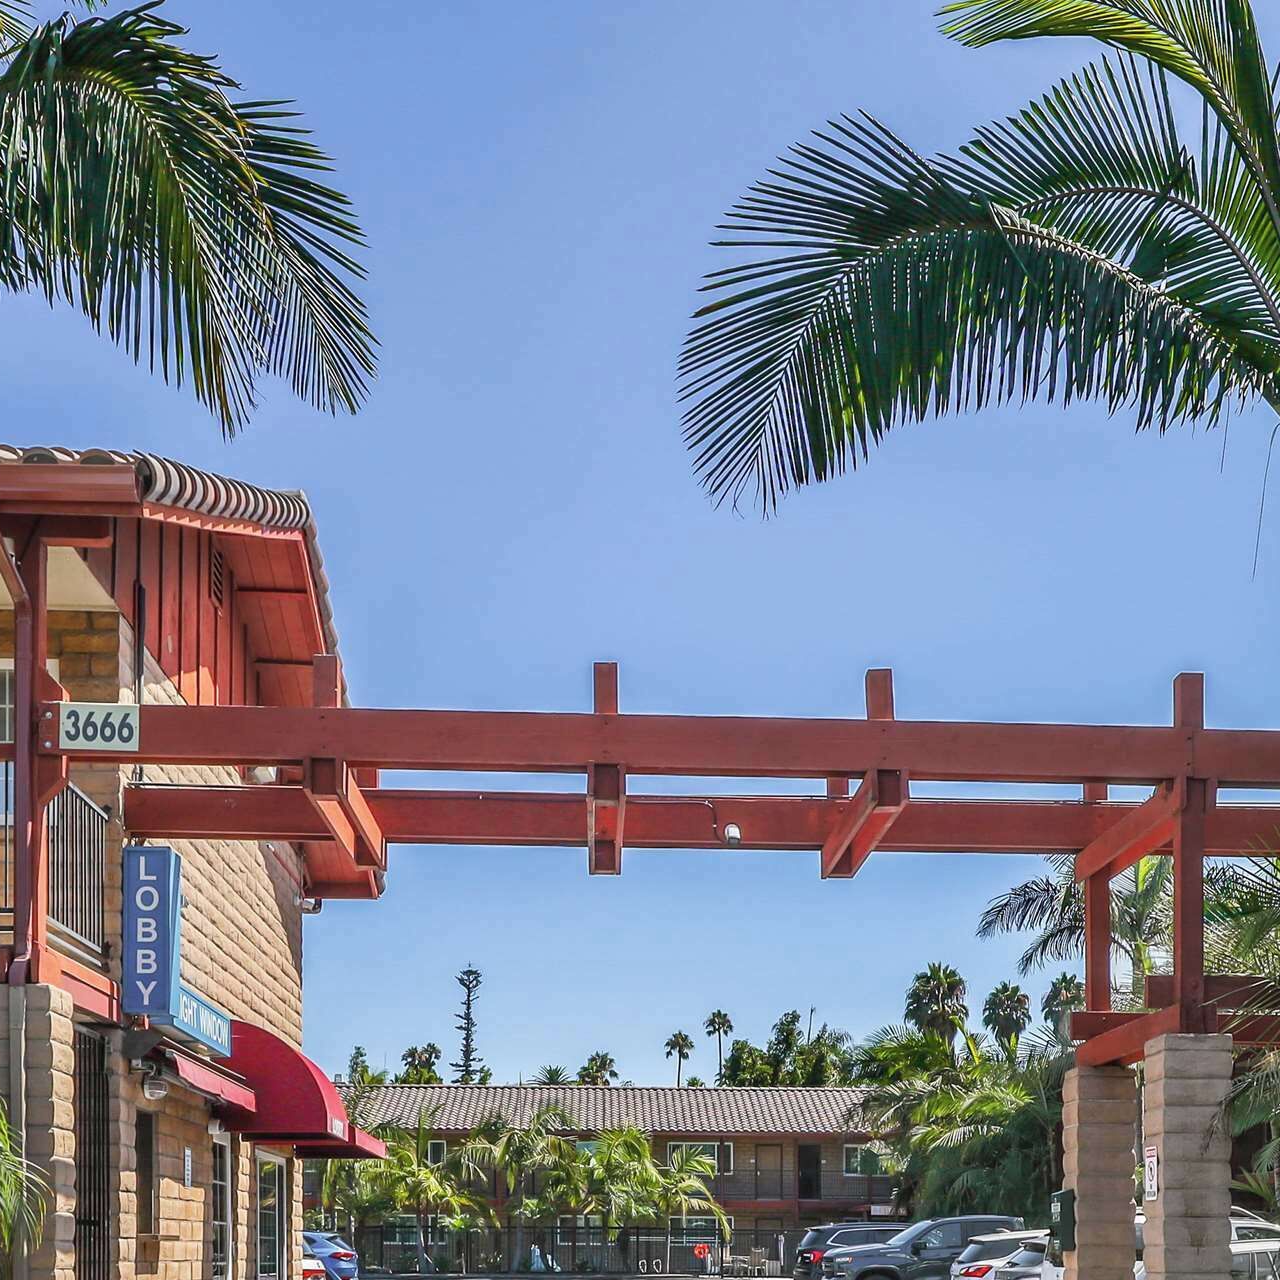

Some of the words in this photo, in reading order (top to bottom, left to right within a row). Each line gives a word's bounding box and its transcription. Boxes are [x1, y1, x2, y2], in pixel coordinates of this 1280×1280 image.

[64, 709, 134, 743] 3666
[135, 856, 159, 1006] LOBBY
[179, 993, 197, 1029] IGHT
[199, 1006, 229, 1048] WINDOW
